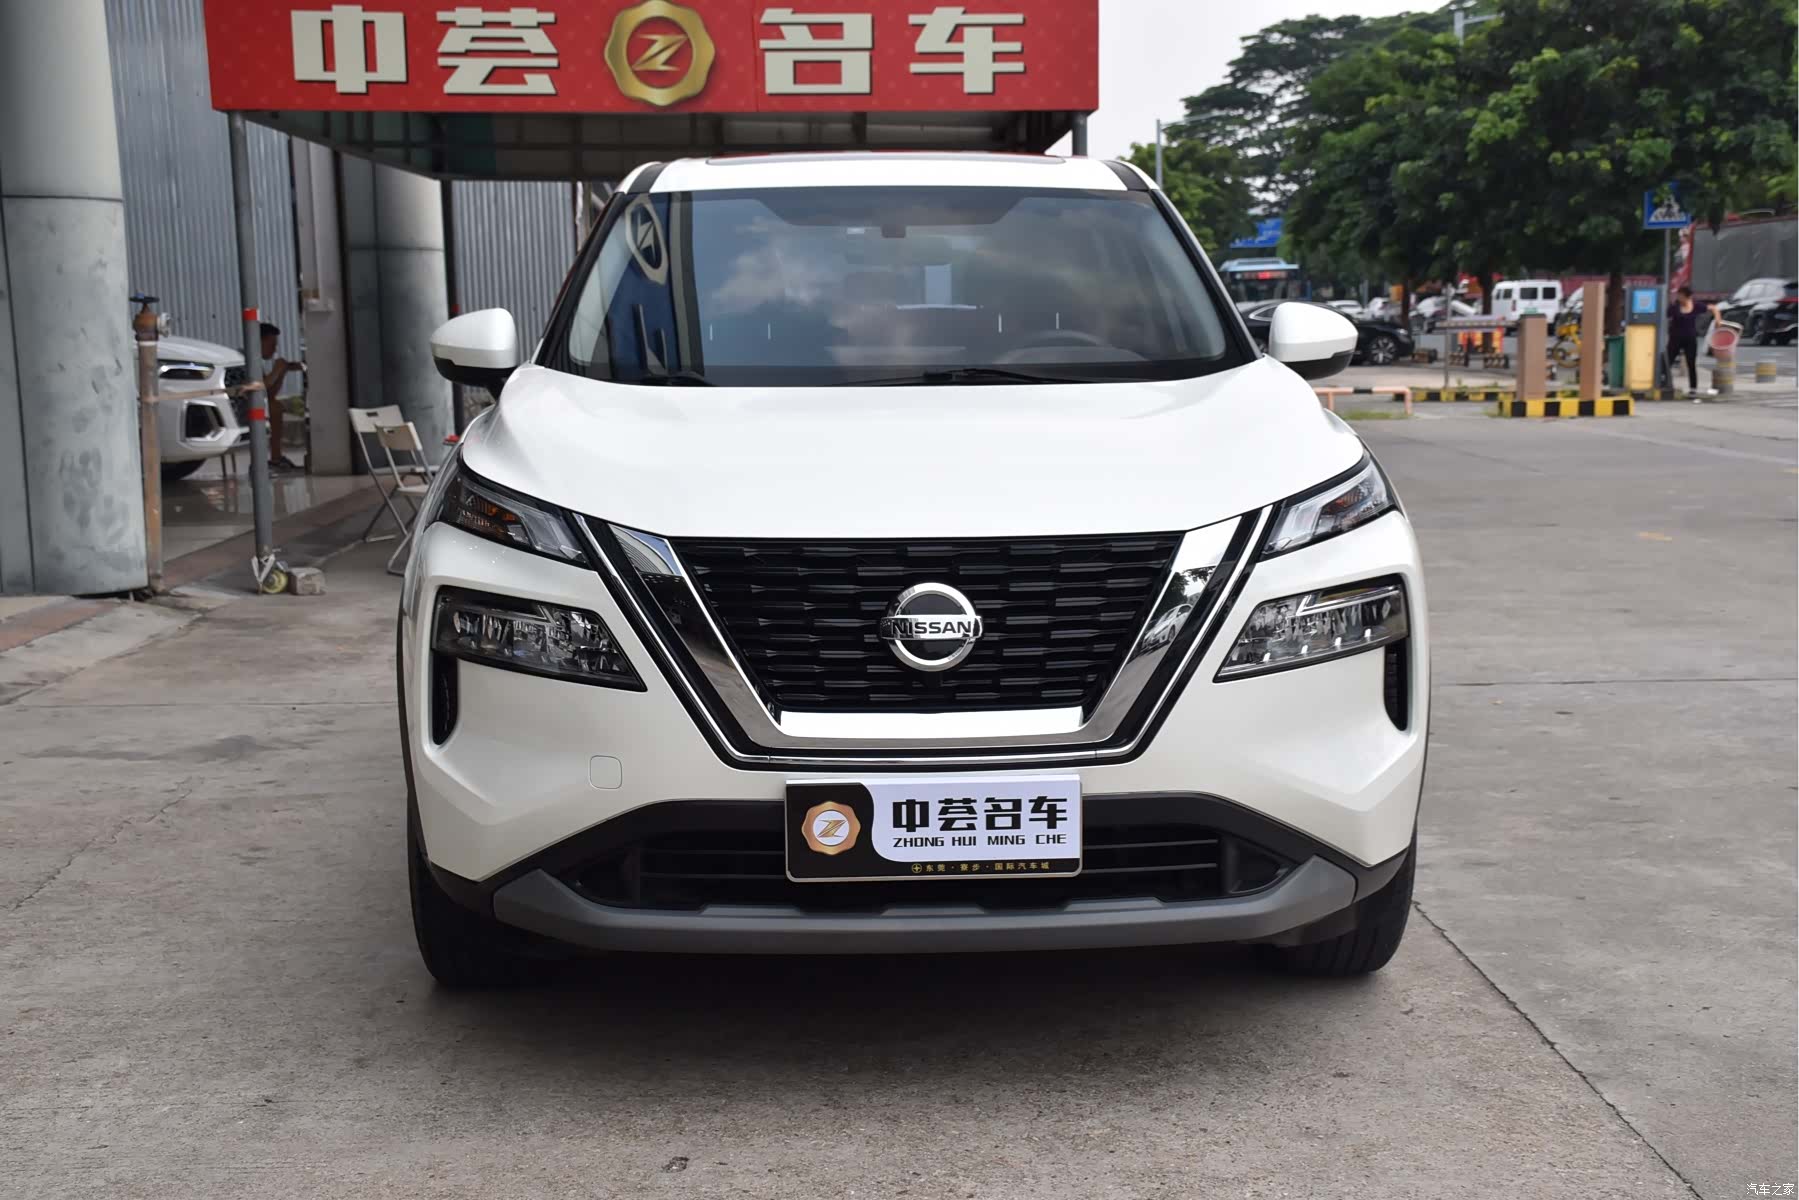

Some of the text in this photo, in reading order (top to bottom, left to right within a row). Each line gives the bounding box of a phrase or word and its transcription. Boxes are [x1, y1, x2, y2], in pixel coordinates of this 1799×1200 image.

[892, 621, 972, 635] NISSAN
[892, 796, 1068, 832] 中荟名车
[893, 834, 1067, 848] ZHONG HUI MING CHE
